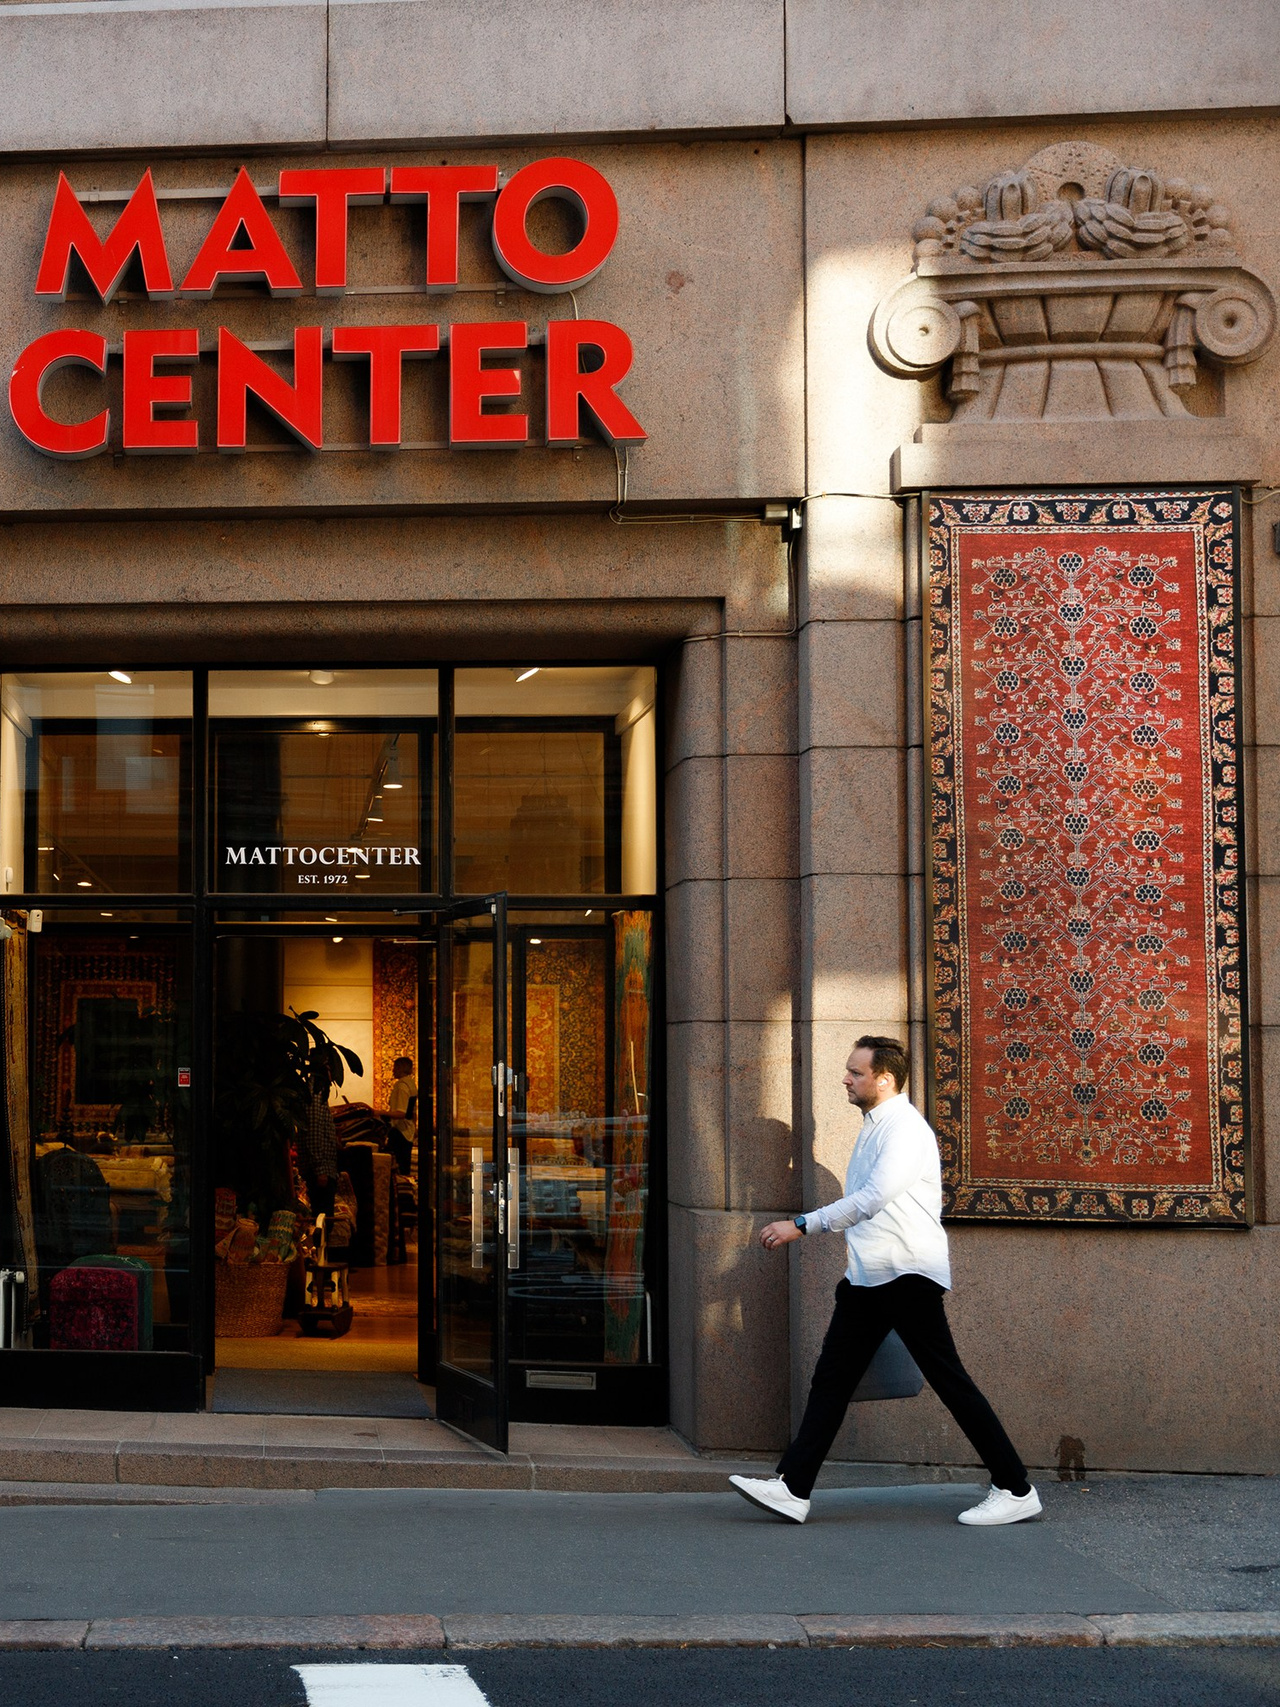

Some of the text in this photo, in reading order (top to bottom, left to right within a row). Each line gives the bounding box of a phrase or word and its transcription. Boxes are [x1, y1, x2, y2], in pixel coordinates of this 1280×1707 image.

[35, 157, 620, 302] MATTO
[8, 320, 649, 459] CENTER
[225, 846, 422, 866] MATTOCENTER
[297, 874, 348, 885] EST. 1972
